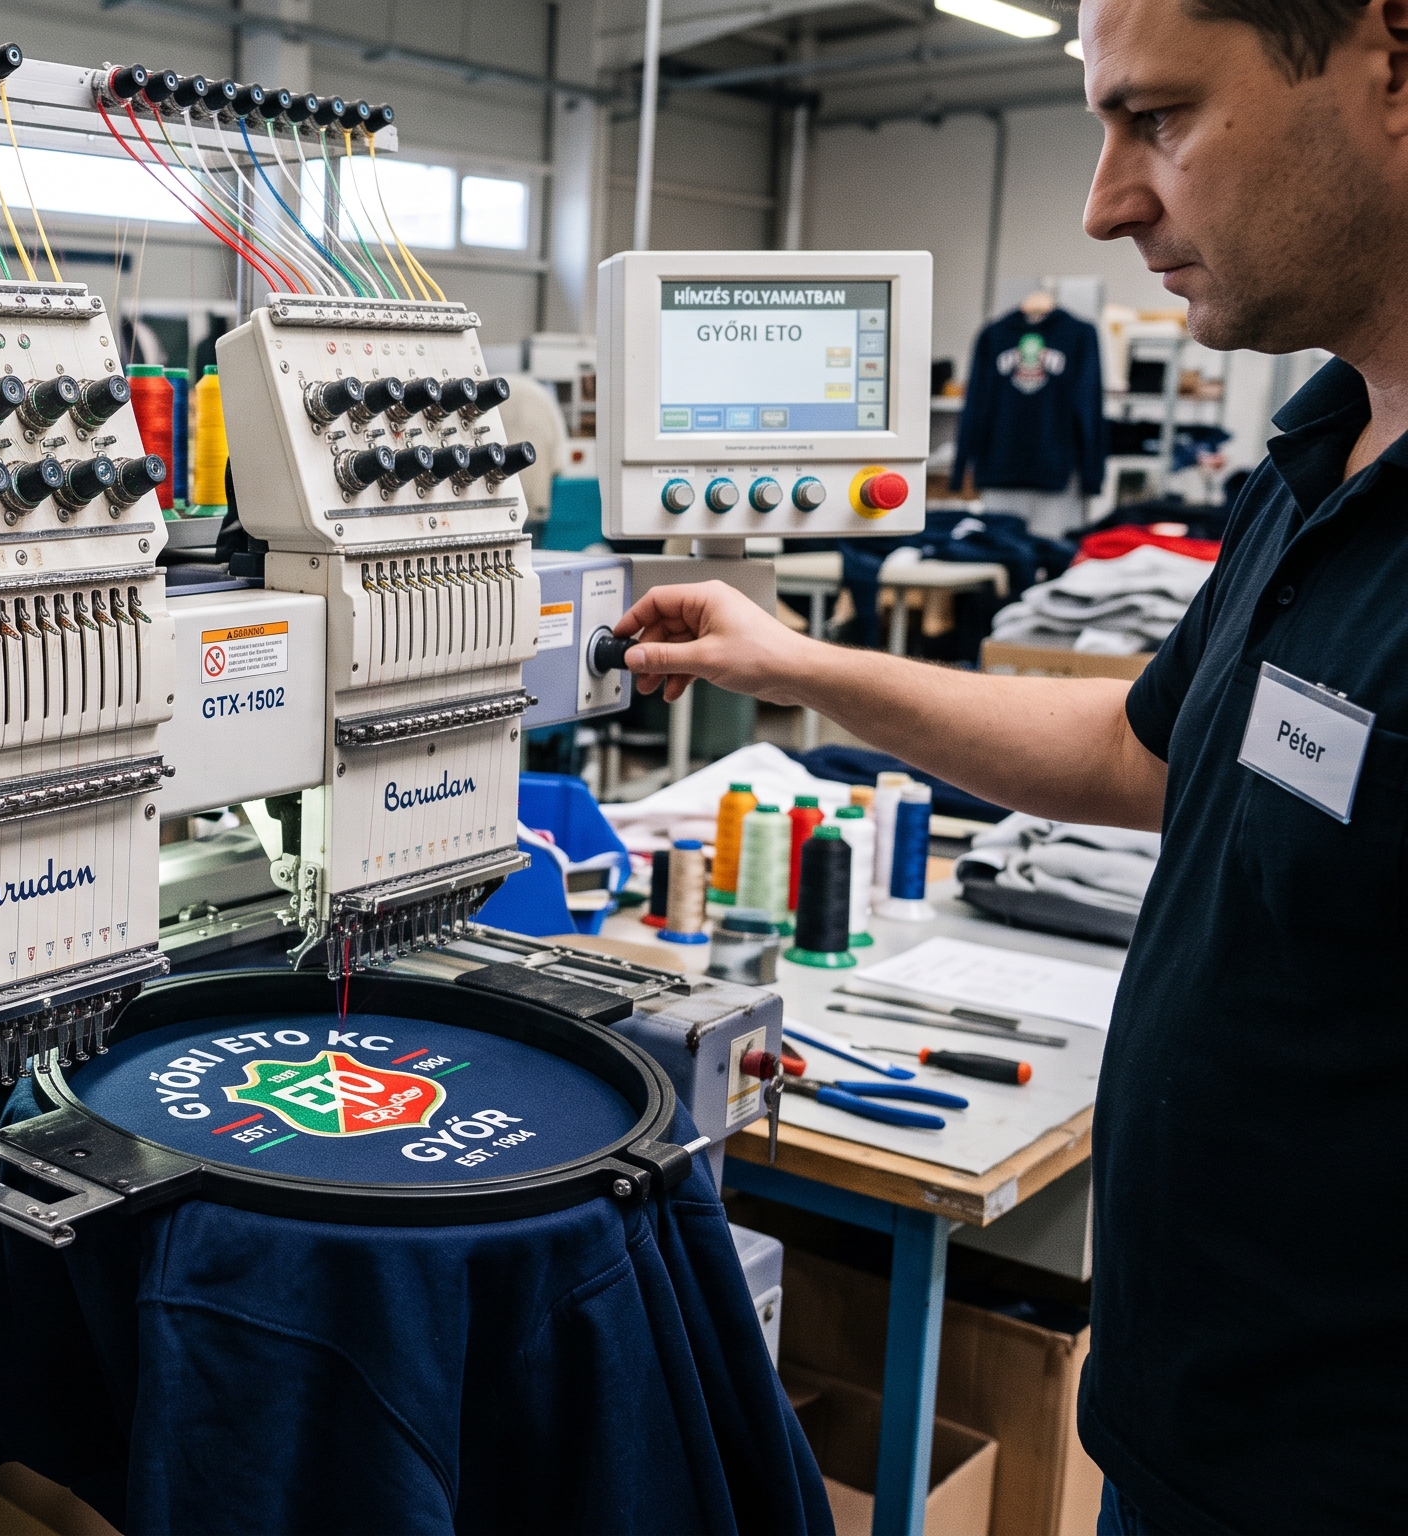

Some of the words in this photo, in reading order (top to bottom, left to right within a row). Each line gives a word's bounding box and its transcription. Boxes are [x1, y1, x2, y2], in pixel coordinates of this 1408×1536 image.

[674, 286, 730, 305] HÍMZÉS
[733, 289, 846, 305] FOLYAMATBAN
[697, 319, 757, 342] GYŐRI
[765, 324, 802, 342] ETO
[202, 686, 285, 719] GTX-1502
[1276, 719, 1326, 763] Péter
[384, 769, 477, 812] Barudan
[211, 1029, 310, 1055] ETO
[327, 1029, 394, 1051] KC
[412, 1054, 452, 1071] 1904
[231, 1124, 278, 1144] EST.
[454, 1148, 499, 1168] EST.
[492, 1129, 537, 1149] 1904
